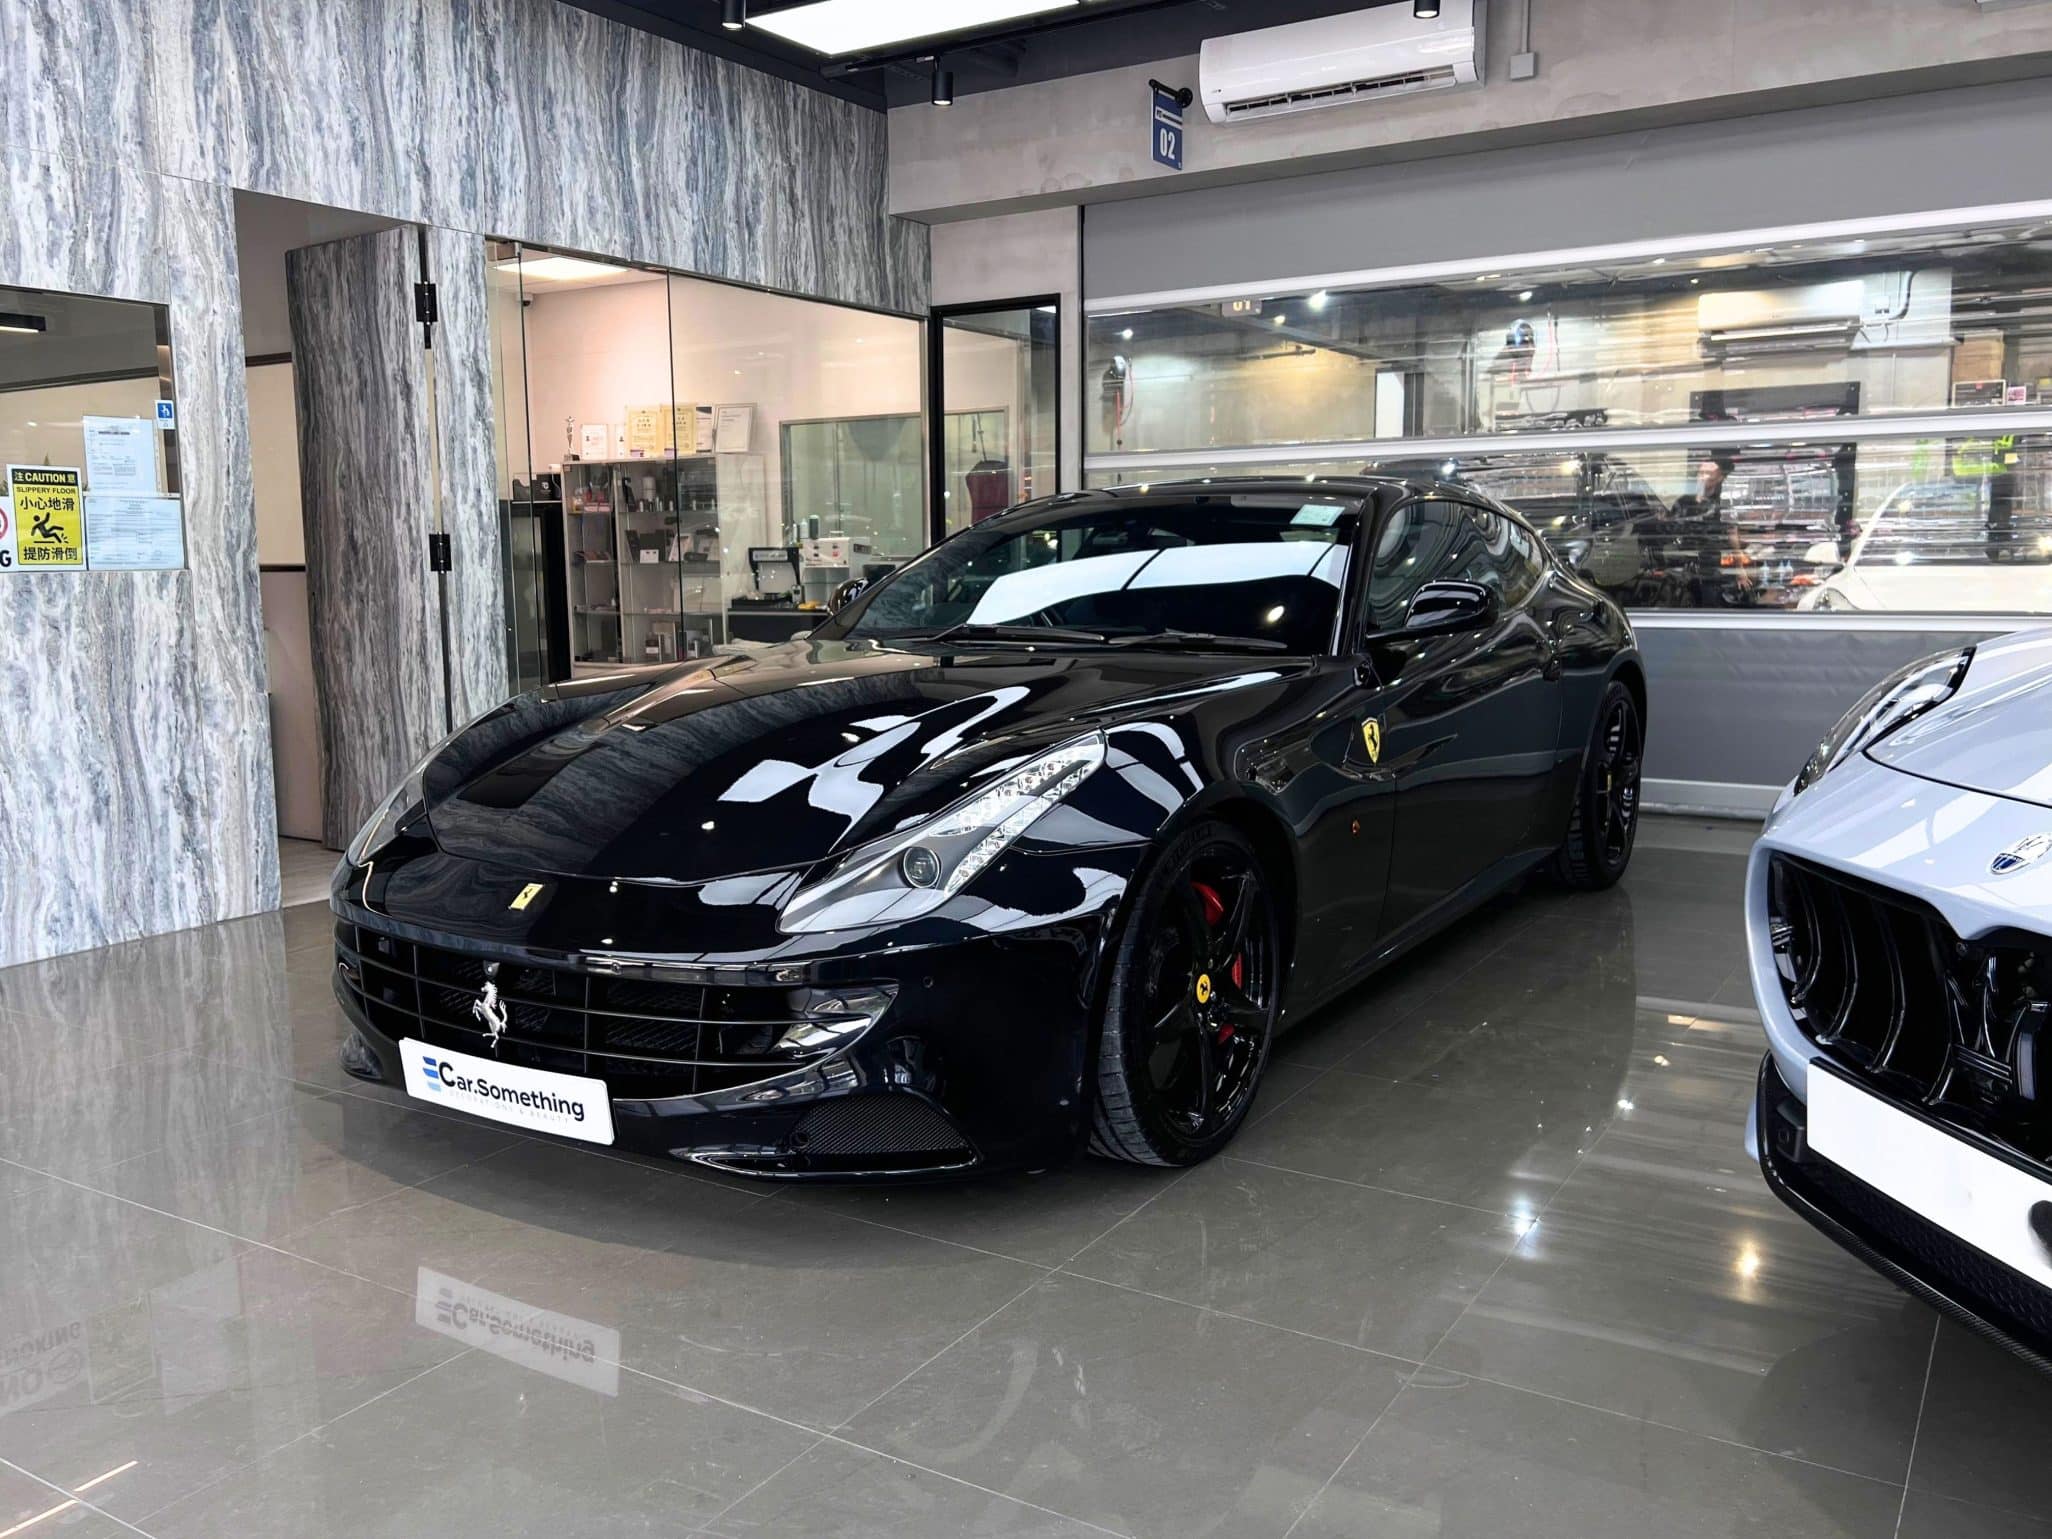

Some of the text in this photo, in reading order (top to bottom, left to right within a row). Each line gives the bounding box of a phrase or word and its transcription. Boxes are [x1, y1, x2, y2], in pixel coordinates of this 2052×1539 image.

[1160, 128, 1176, 160] 02
[25, 472, 66, 483] CAUTION
[16, 486, 76, 495] SLIPPERY FLOOR
[20, 496, 75, 511] 小心地滑
[23, 546, 78, 561] 提防滑倒
[438, 1061, 585, 1122] Car.Something
